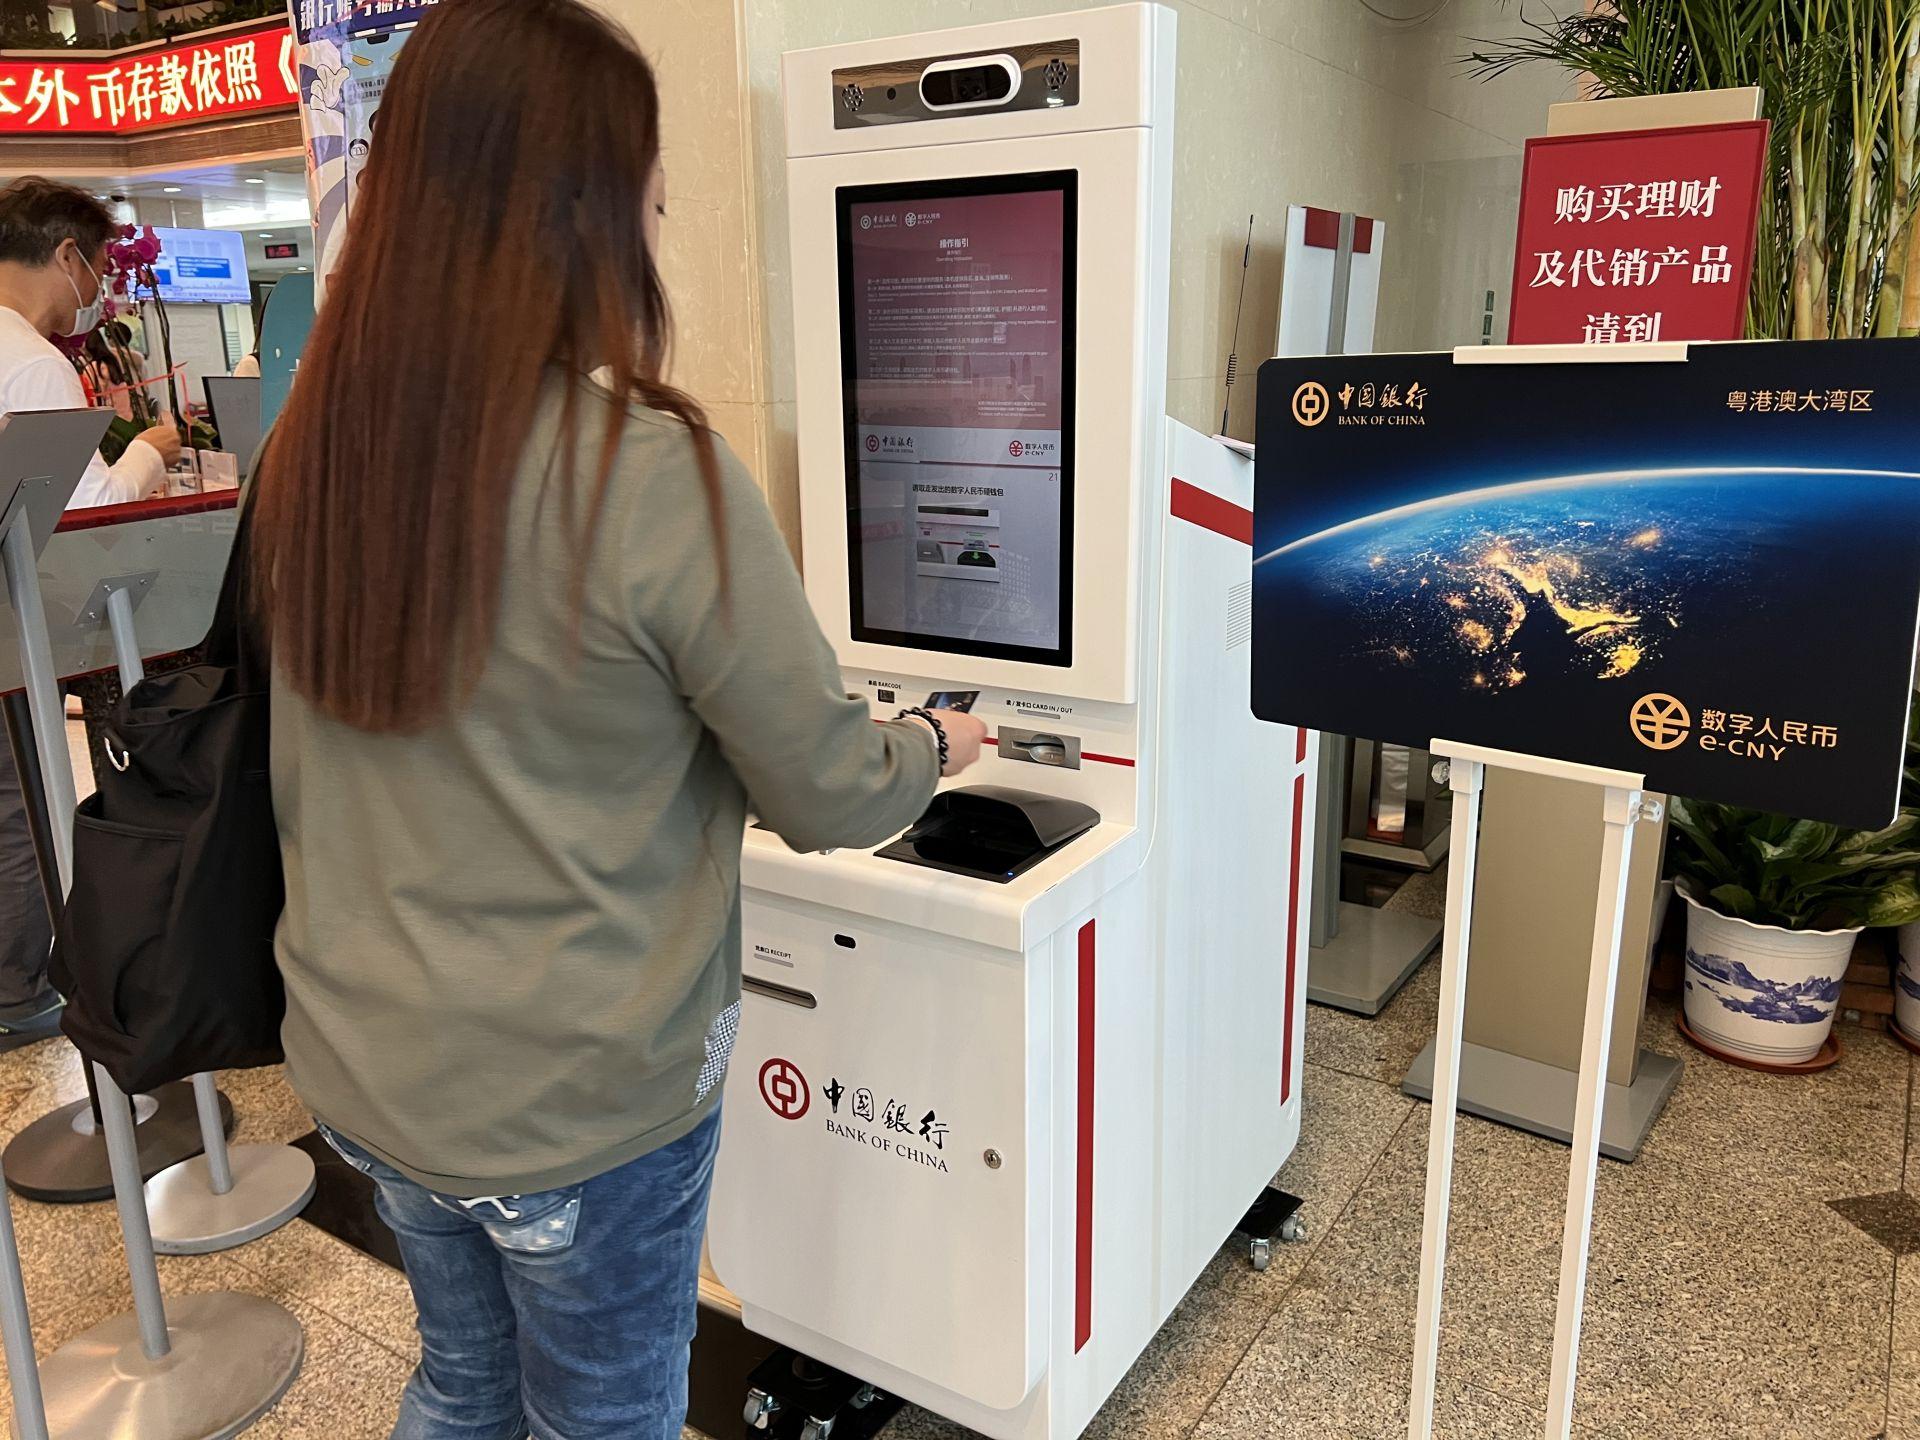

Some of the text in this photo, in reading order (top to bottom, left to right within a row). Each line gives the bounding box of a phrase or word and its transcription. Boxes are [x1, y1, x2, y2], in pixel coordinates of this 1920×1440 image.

[1553, 175, 1722, 224] 购买理财
[1528, 244, 1733, 288] 及代销产品
[1582, 311, 1662, 344] 请到
[1726, 389, 1874, 412] 粤港澳大湾区
[1338, 415, 1425, 425] BANK OF CHINA
[1048, 473, 1058, 481] 21
[1700, 708, 1838, 748] 数字人民币
[1699, 735, 1787, 761] e-CNY
[826, 1119, 948, 1173] BANK OF CHINA
